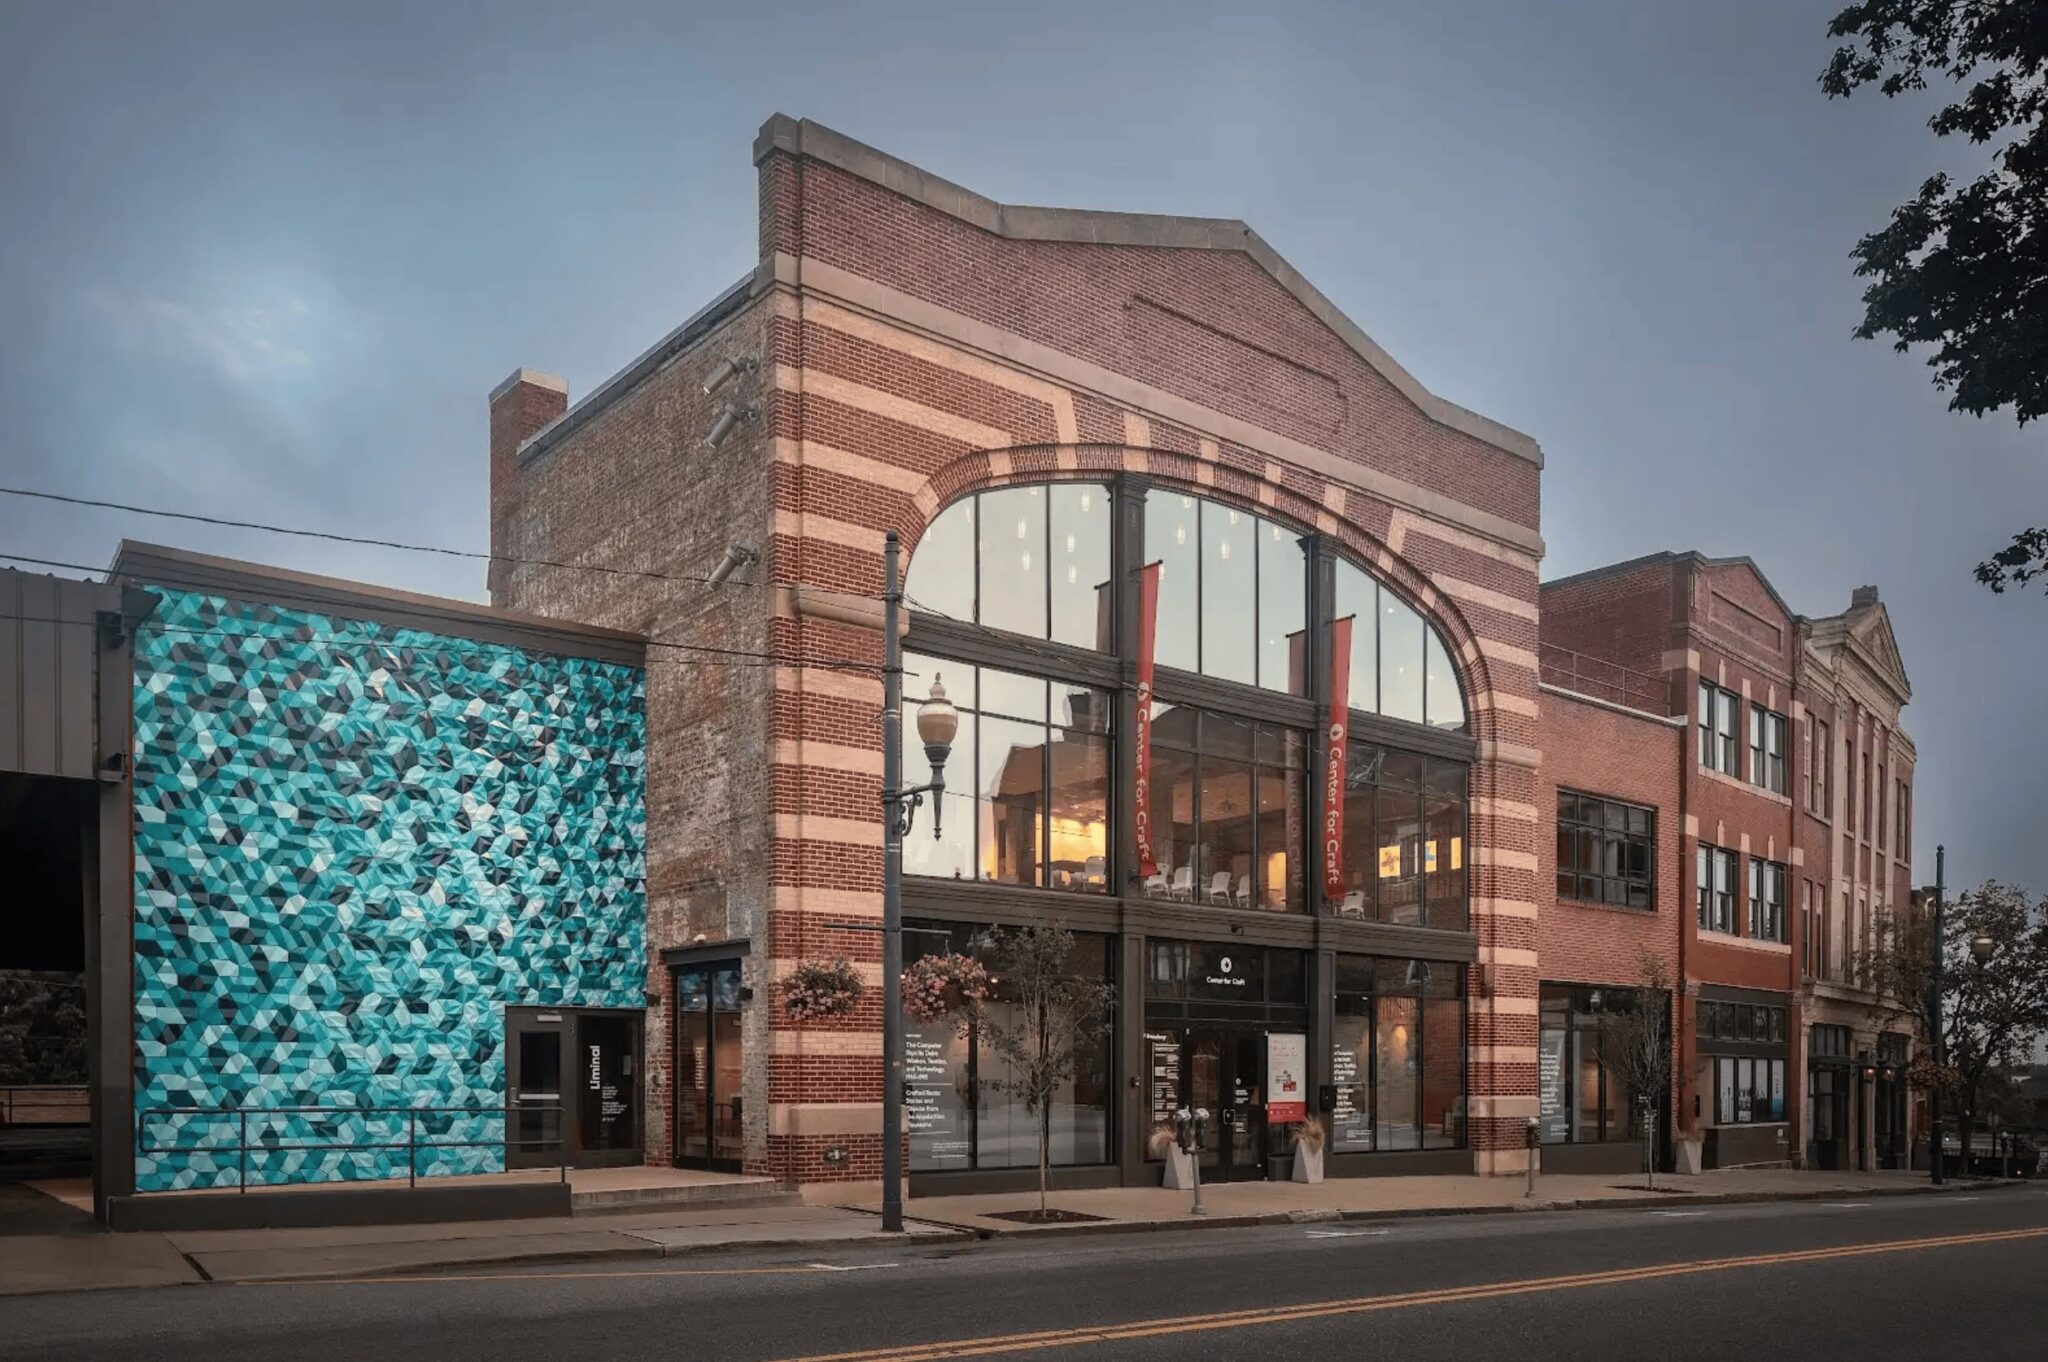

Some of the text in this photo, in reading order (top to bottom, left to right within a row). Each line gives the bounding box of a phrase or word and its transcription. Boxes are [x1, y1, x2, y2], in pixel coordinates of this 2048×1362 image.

[1136, 708, 1150, 861] Center for Craft
[1327, 747, 1342, 885] Center for Craft
[589, 1045, 600, 1090] Liminal
